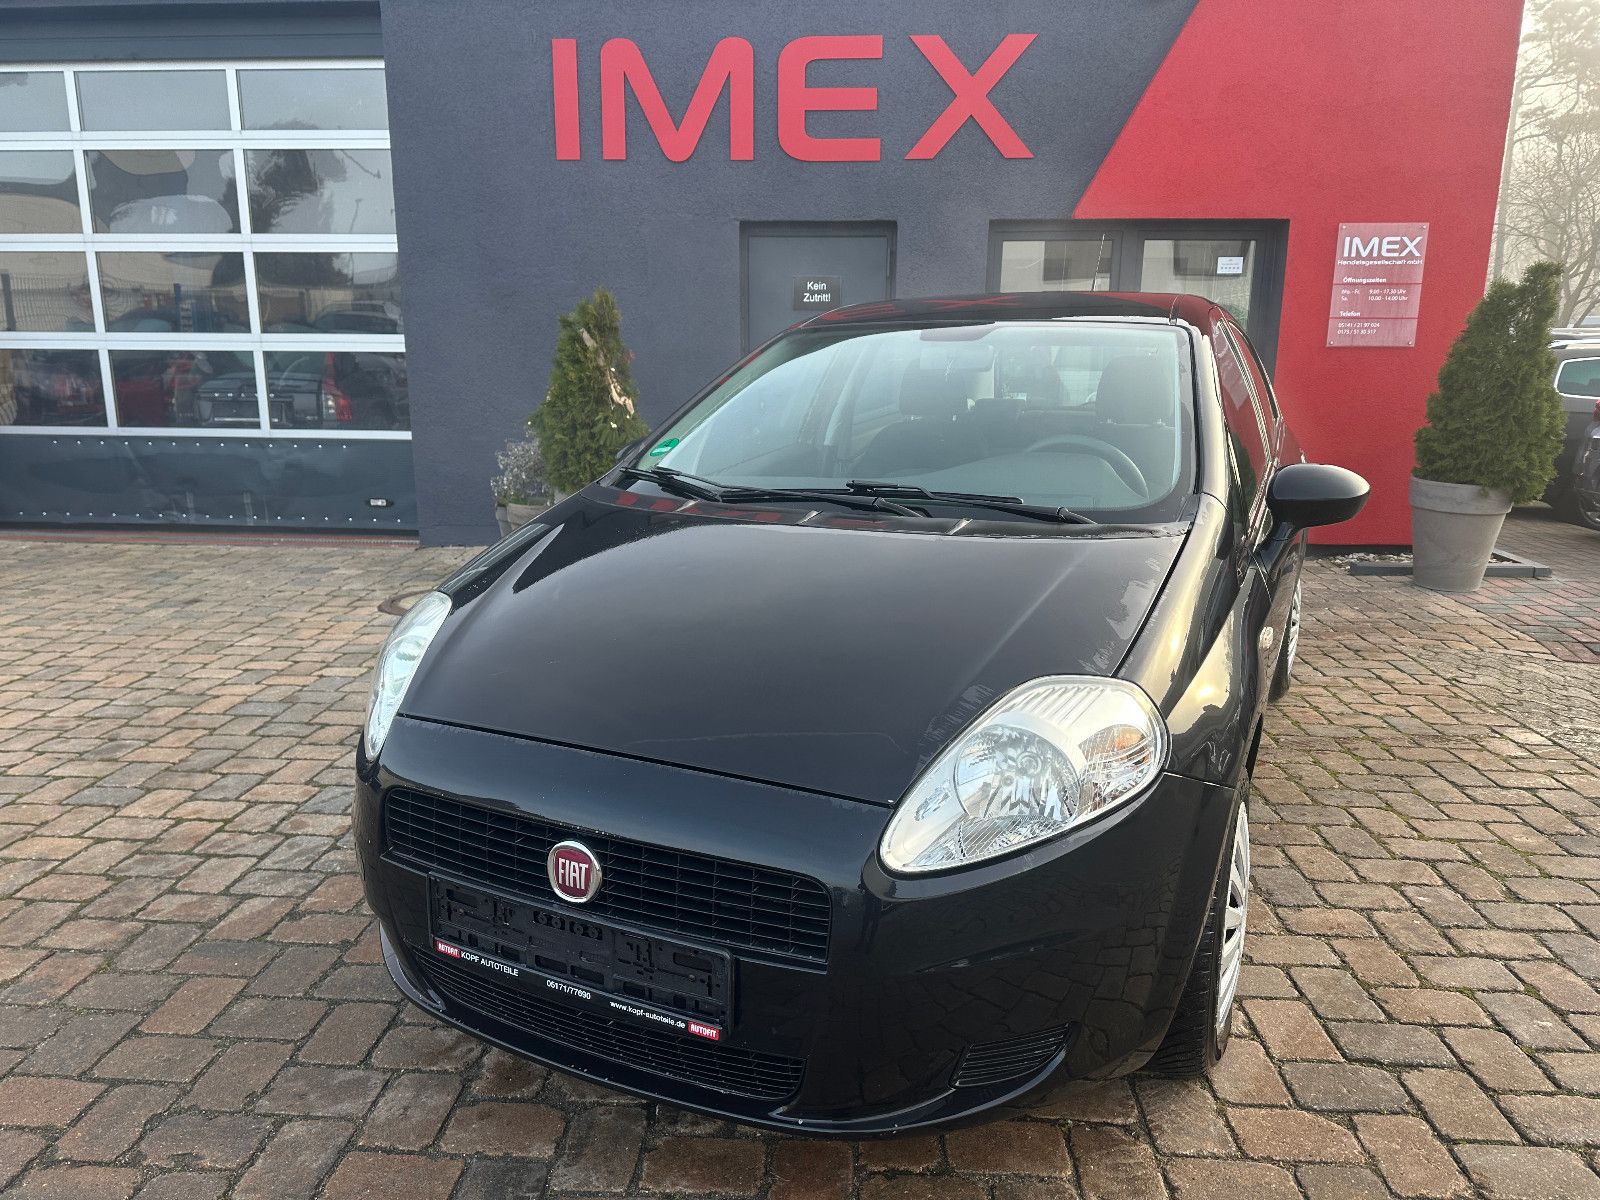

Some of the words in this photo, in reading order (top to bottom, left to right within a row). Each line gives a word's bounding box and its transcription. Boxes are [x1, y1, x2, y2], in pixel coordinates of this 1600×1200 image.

[551, 34, 1038, 162] IMEX
[1343, 236, 1423, 257] IMEX
[807, 281, 827, 290] Kein
[1342, 276, 1387, 284] Öffnungszeiten
[803, 293, 831, 302] Zutritt!
[559, 858, 589, 890] FIAT
[461, 951, 480, 963] KOPF
[481, 958, 519, 977] AUTOTEILE
[690, 1023, 717, 1038] AUTOFIT
